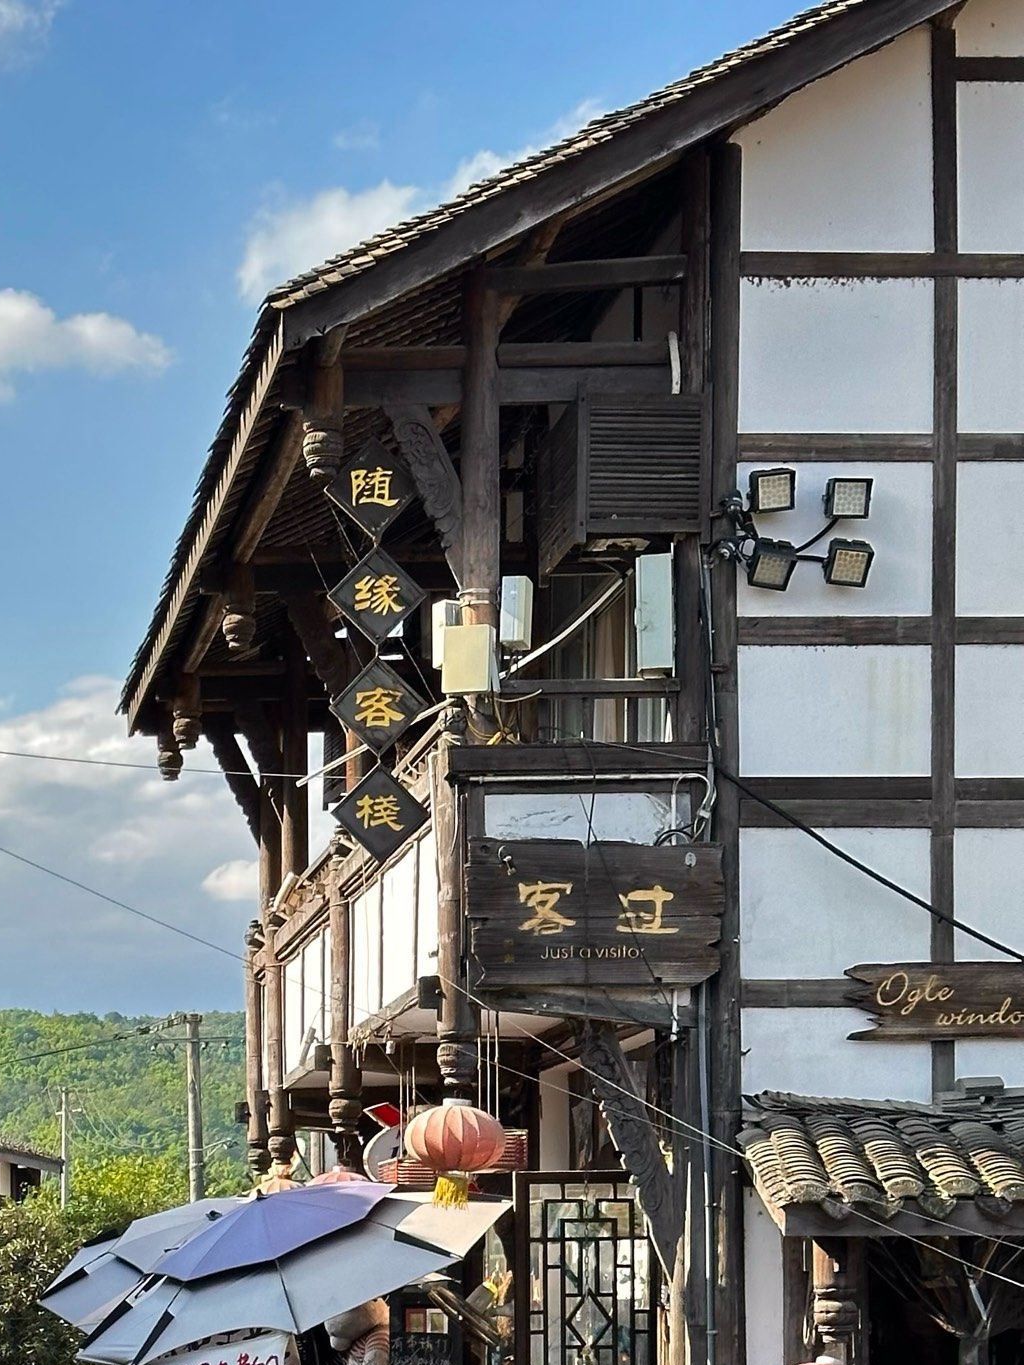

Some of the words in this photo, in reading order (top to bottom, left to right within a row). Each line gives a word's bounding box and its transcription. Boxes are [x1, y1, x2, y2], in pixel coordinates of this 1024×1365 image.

[541, 945, 574, 960] Just
[579, 947, 591, 959] a
[595, 945, 645, 959] visitor
[877, 972, 954, 1015] Ogle
